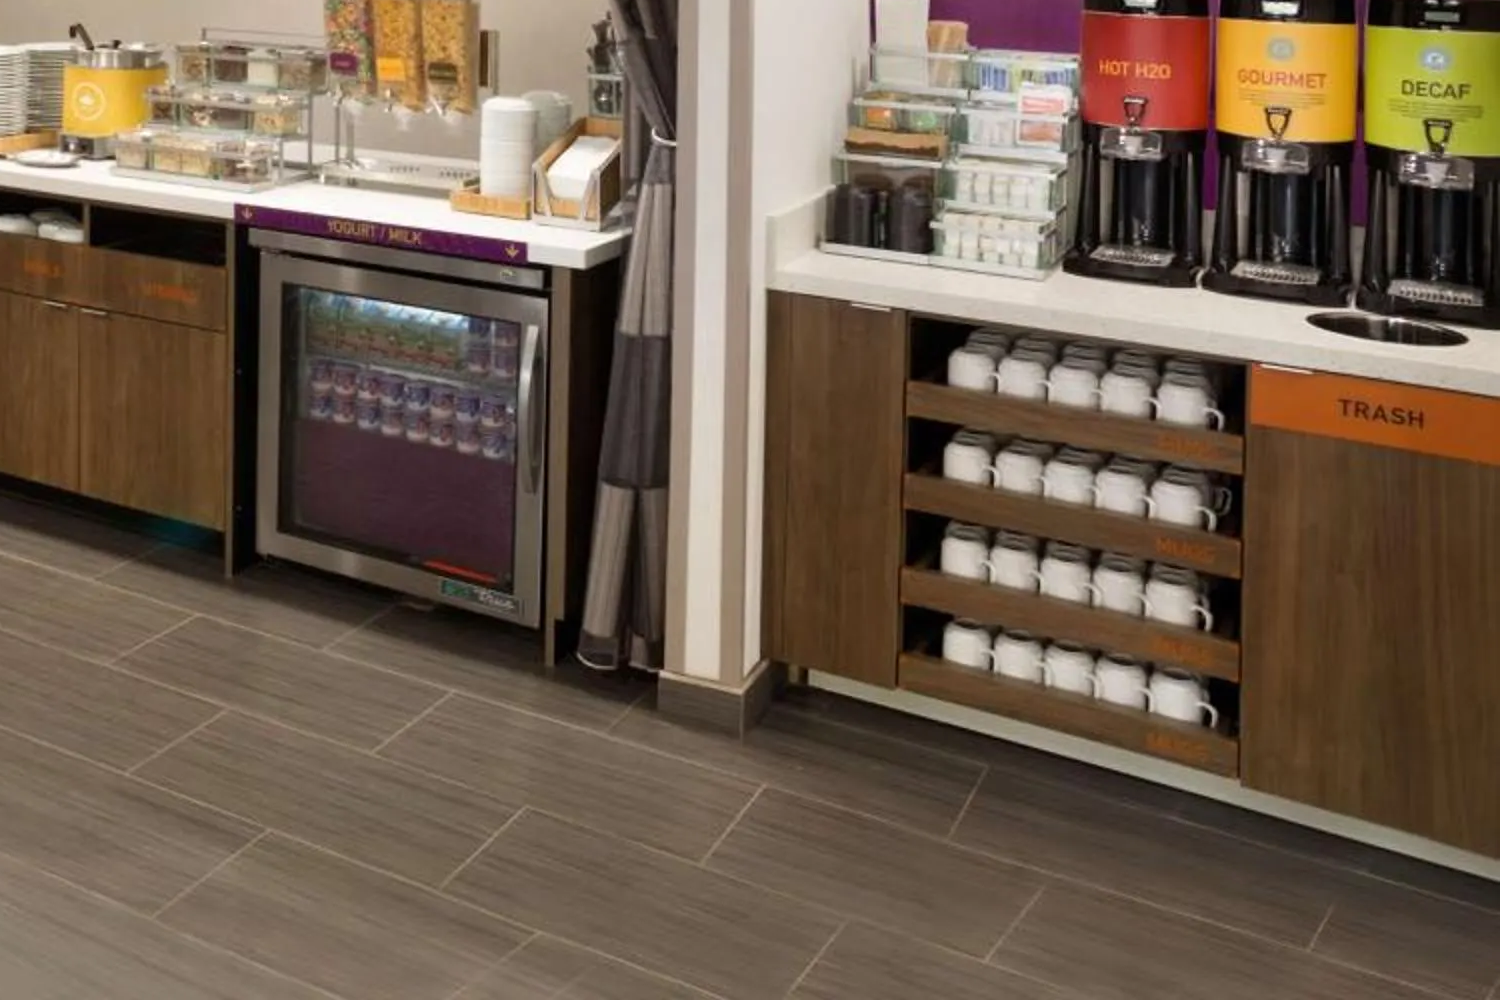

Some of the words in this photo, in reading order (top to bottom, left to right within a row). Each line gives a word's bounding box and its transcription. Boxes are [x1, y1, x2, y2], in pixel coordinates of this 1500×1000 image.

[1099, 59, 1130, 77] HOT
[1135, 62, 1172, 80] H2O
[1238, 68, 1328, 89] GOURMET
[1401, 79, 1472, 100] DECAF
[327, 219, 375, 239] YOGURT
[388, 227, 422, 245] MILK
[1337, 398, 1425, 430] TRASH
